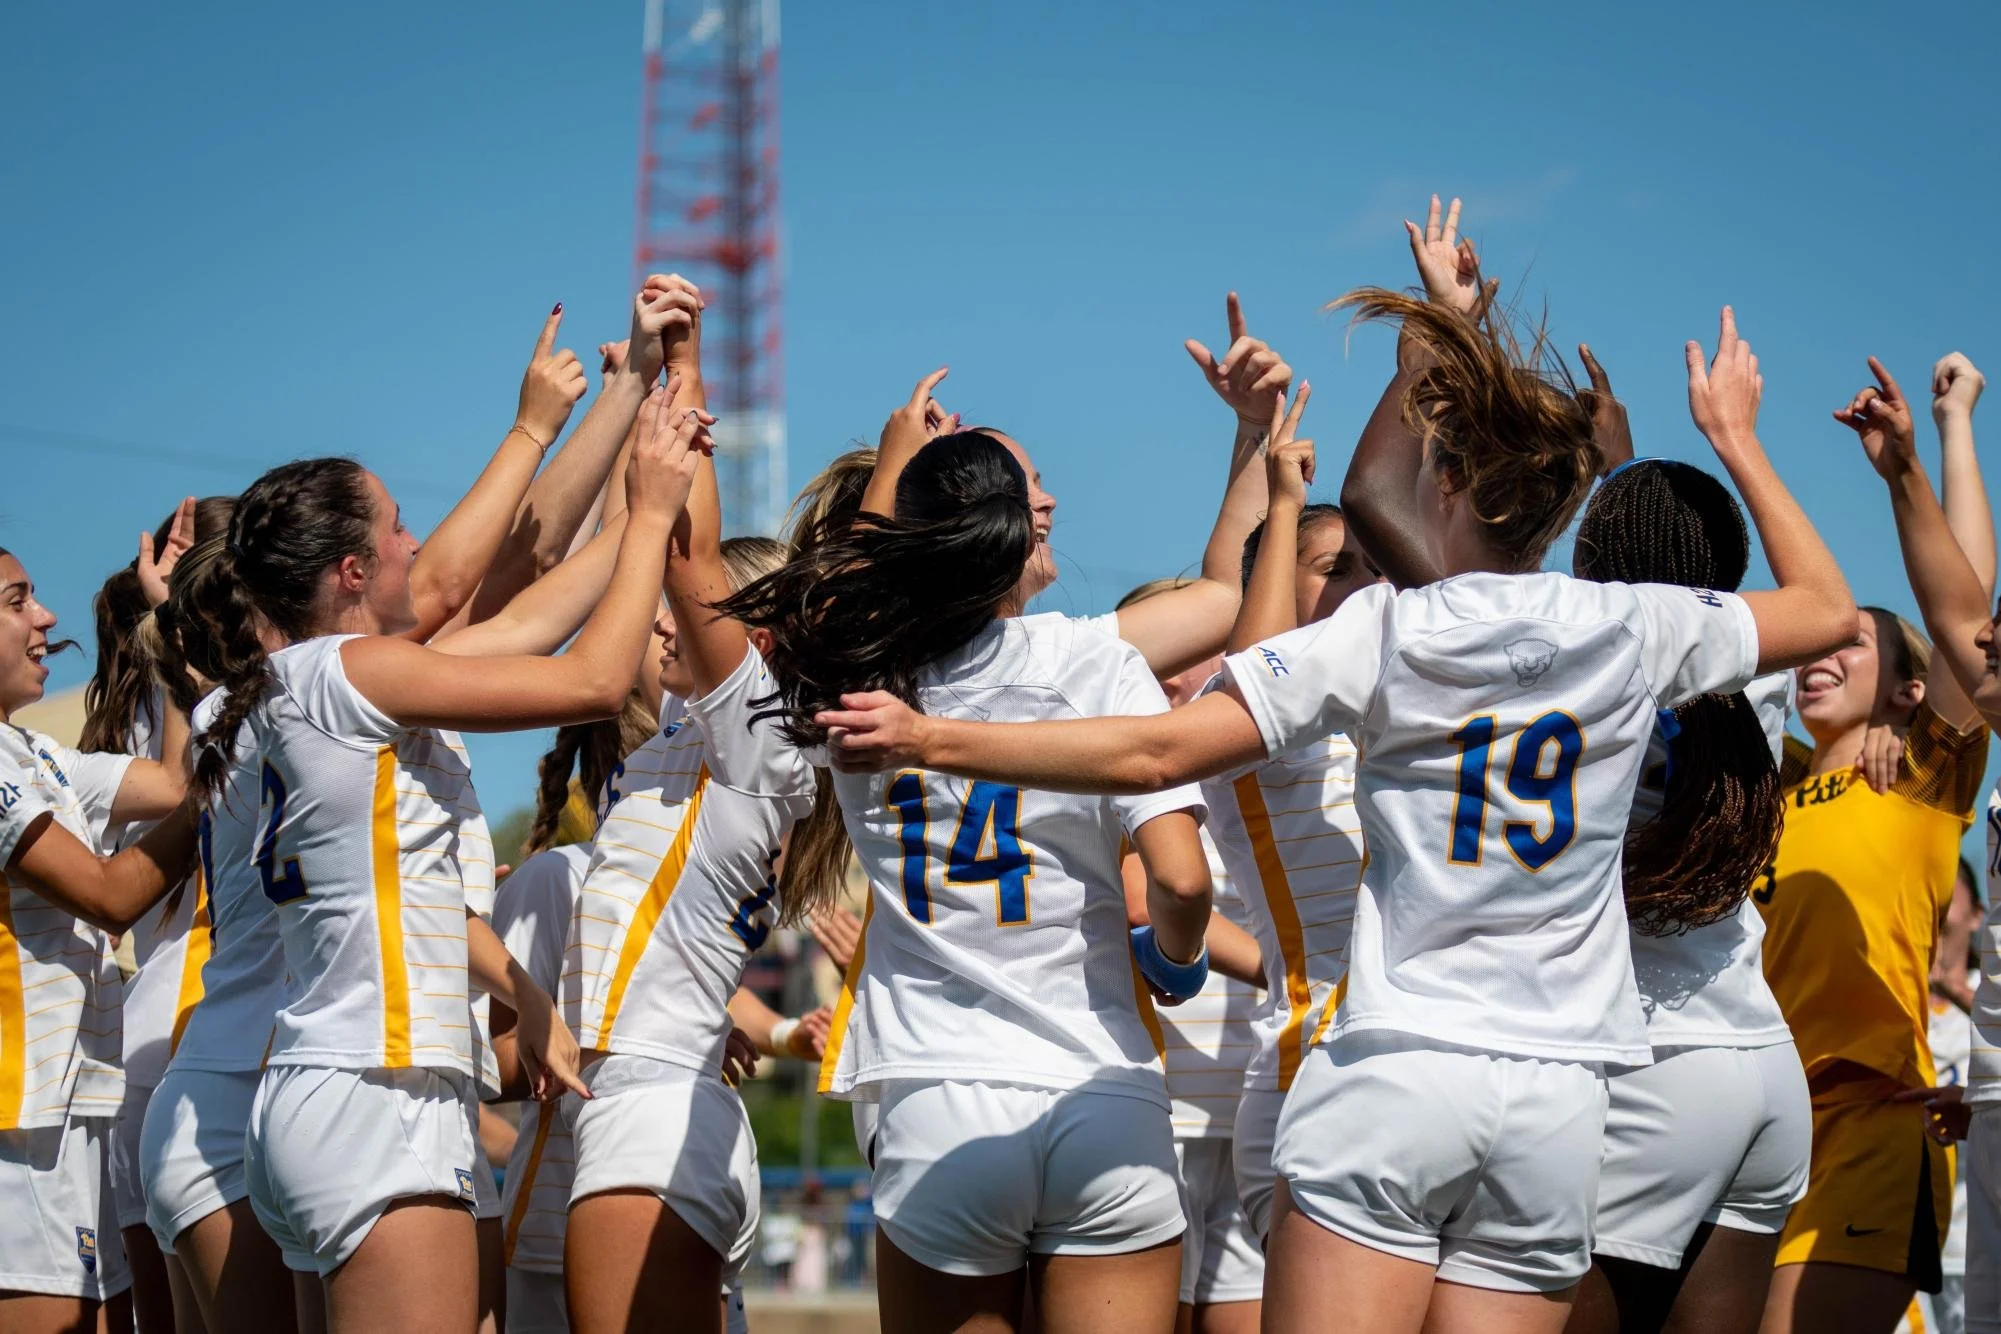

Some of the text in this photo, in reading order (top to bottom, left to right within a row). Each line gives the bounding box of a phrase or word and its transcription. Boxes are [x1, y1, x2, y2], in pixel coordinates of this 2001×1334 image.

[1257, 646, 1289, 677] ACC
[261, 757, 310, 907] 2
[884, 768, 1036, 928] 14
[1447, 708, 1587, 873] 19
